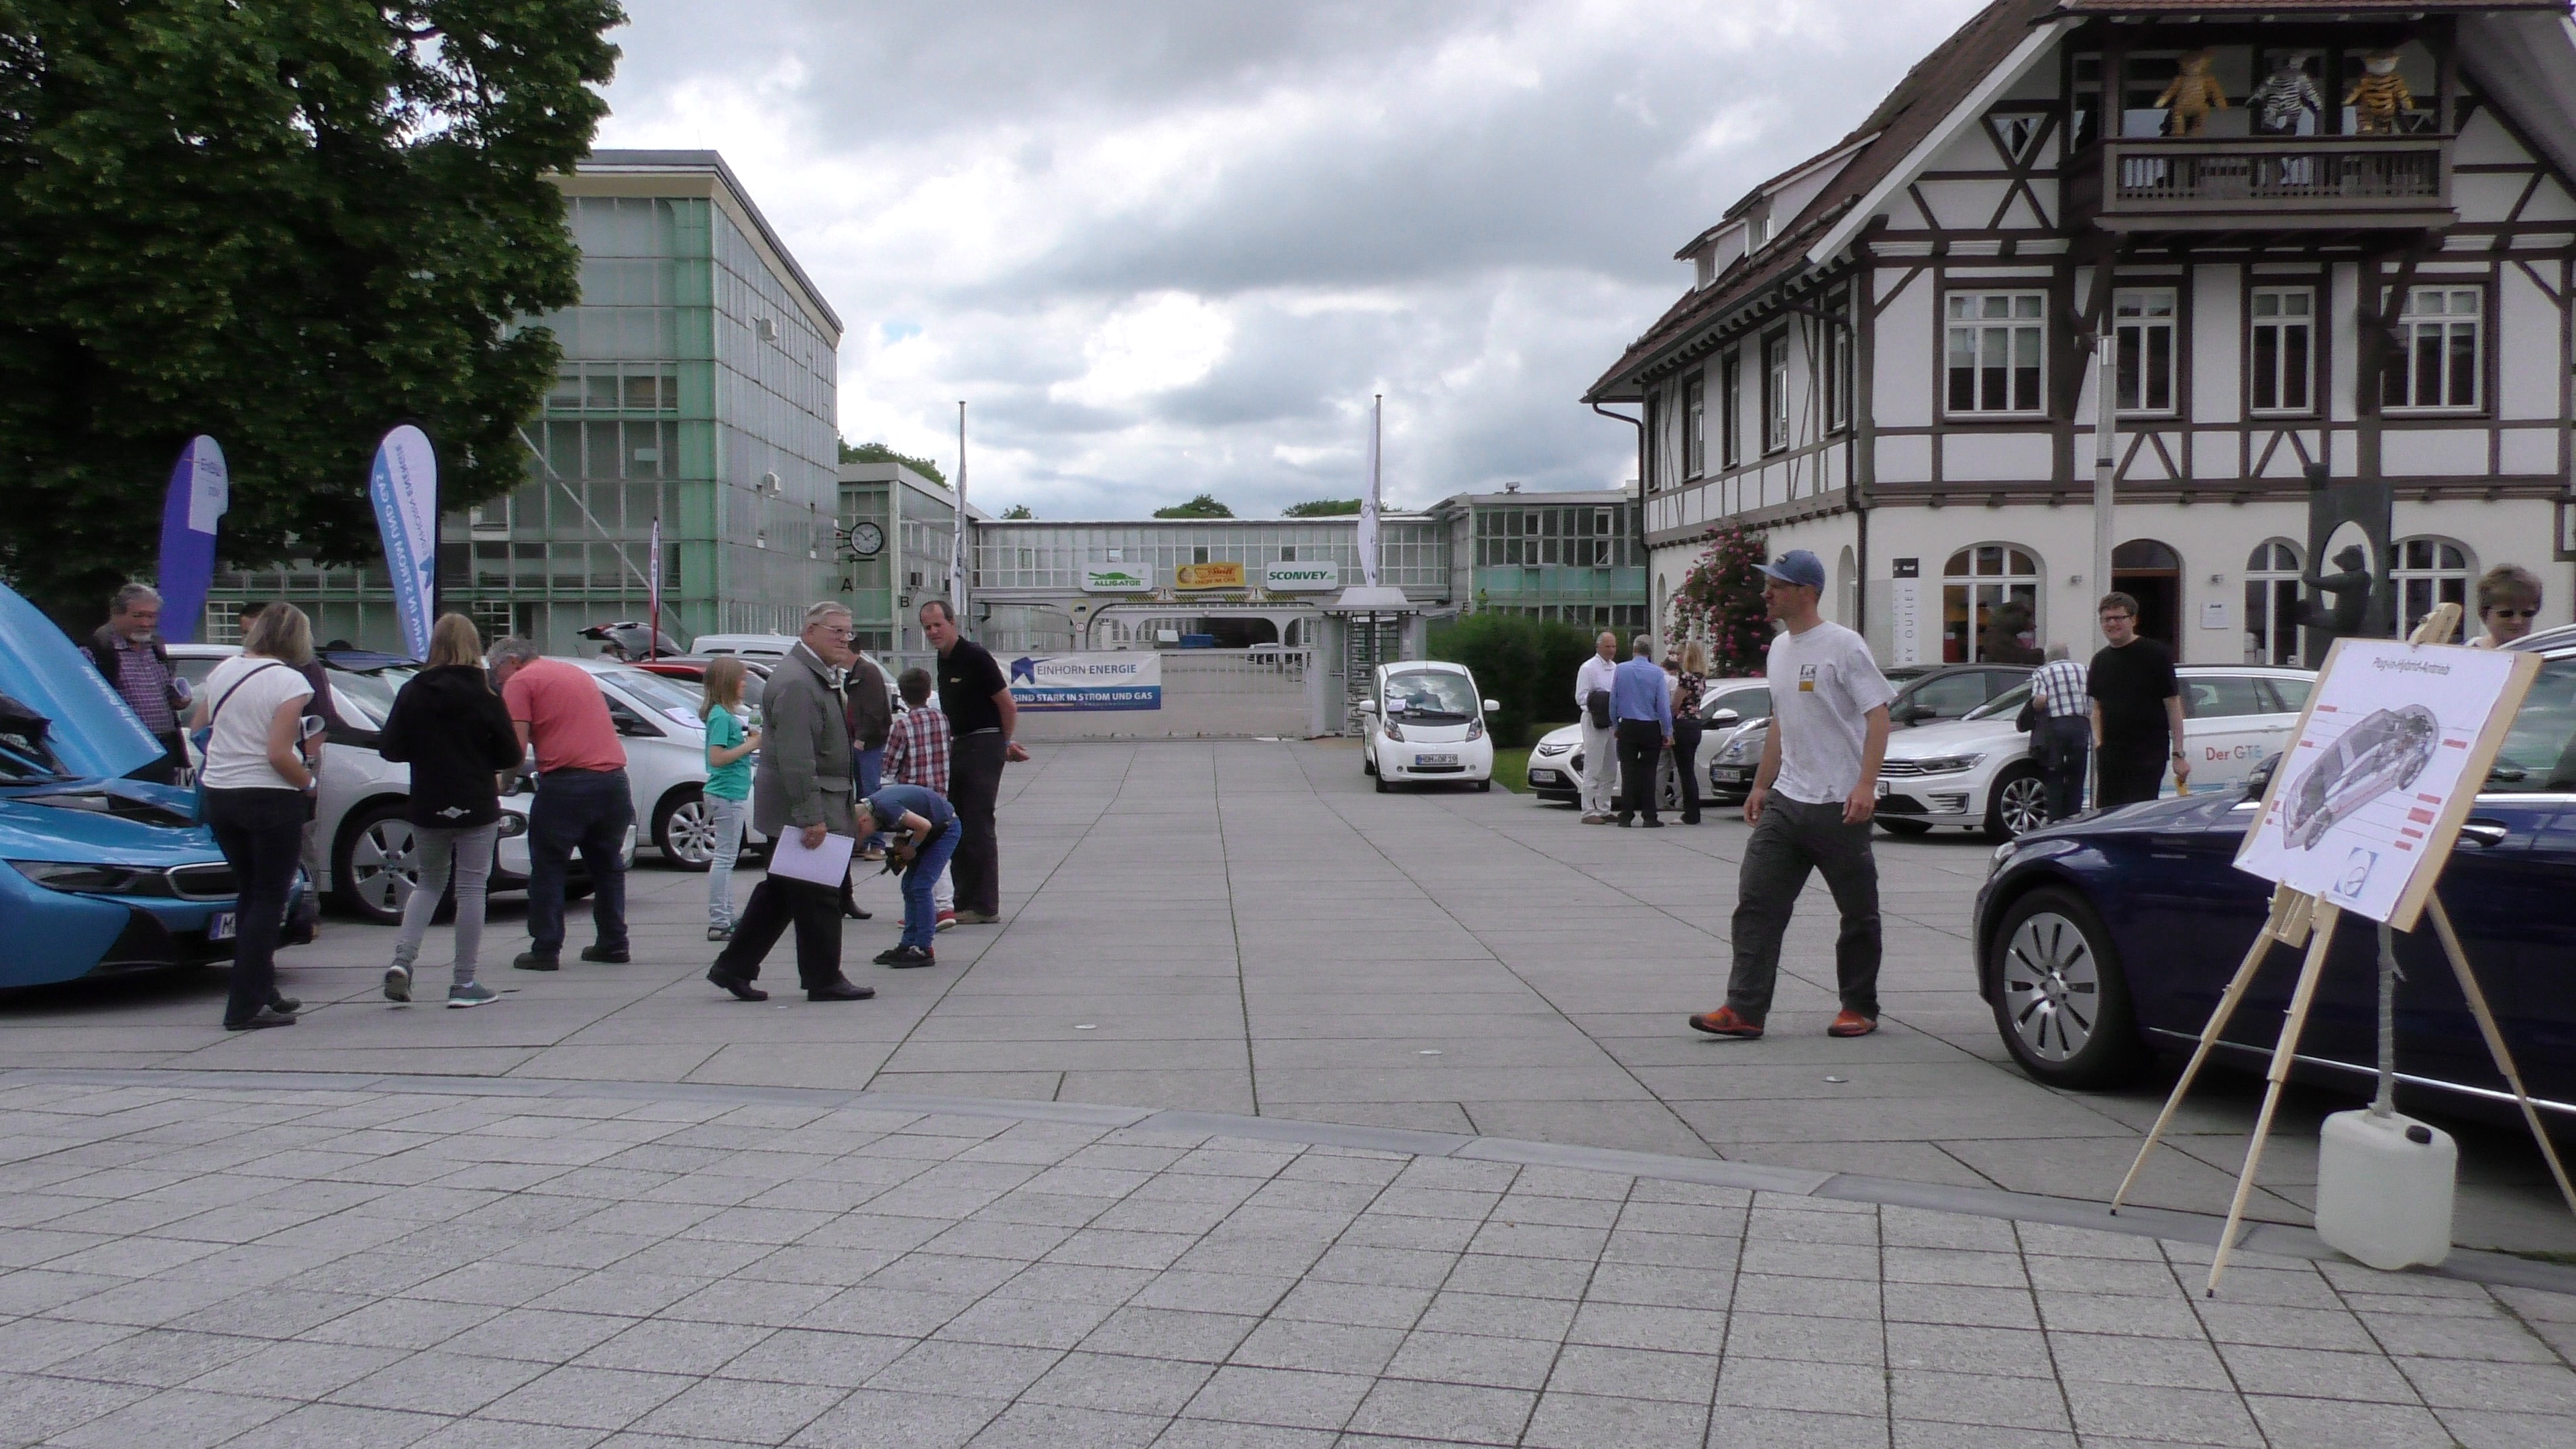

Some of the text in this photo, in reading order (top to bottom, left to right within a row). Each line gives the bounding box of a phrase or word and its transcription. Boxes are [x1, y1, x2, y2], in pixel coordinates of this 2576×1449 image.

[1268, 571, 1328, 580] SCONVEY
[841, 578, 853, 591] A
[900, 596, 910, 607] B
[1037, 664, 1137, 675] EINHORN ENERGIE
[1134, 692, 1152, 700] GAS
[2206, 745, 2261, 761] Der GTE
